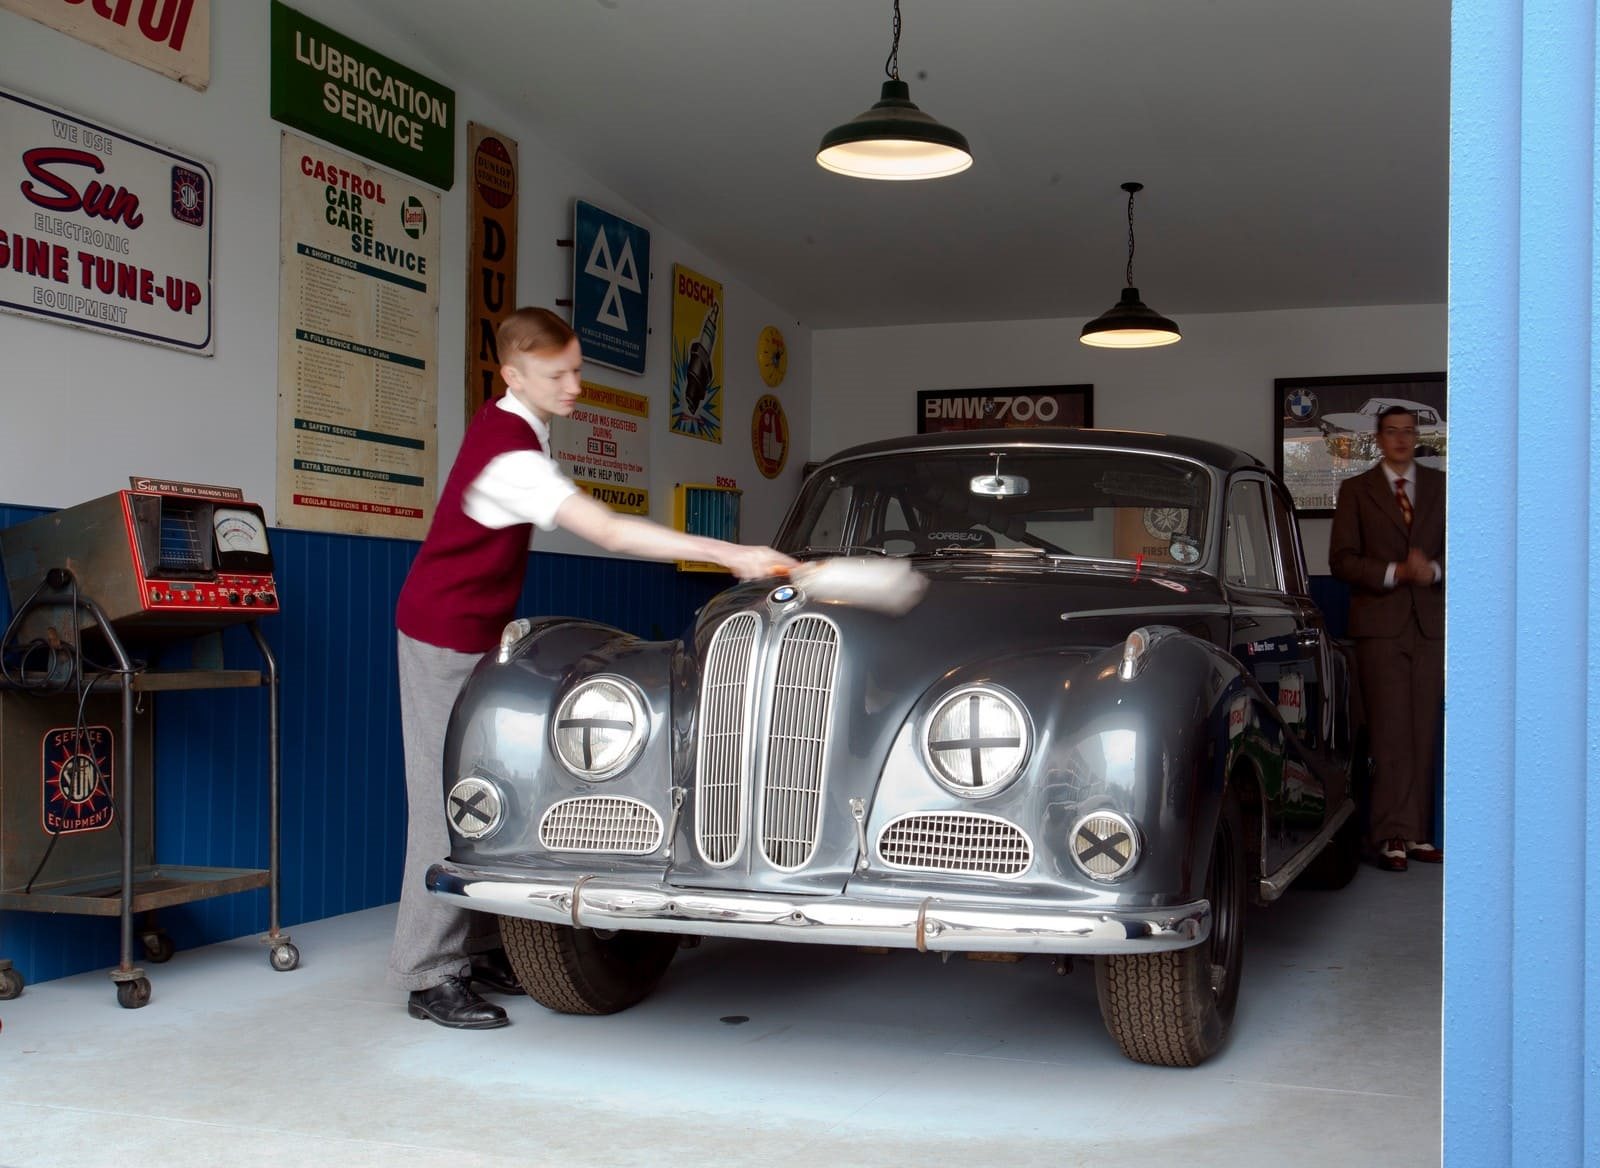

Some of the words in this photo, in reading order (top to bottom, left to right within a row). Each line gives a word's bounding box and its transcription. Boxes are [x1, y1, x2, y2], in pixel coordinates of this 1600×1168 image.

[296, 31, 447, 128] LUBRICATION
[323, 82, 424, 152] SERVICE
[52, 119, 78, 143] WE
[83, 130, 113, 155] USE
[21, 147, 144, 229] Sun
[301, 155, 386, 205] CASTROL
[325, 185, 362, 215] CAR
[34, 213, 130, 254] ELECTRONIC
[325, 205, 374, 238] CARE
[304, 247, 311, 255] A
[311, 249, 332, 261] SHORT
[333, 254, 358, 270] SERVICE
[351, 234, 426, 275] SERVICE
[78, 251, 201, 315] TUNE-UP
[678, 273, 715, 308] BOSCH
[33, 287, 128, 324] EQUIPMENT
[303, 332, 310, 340] A
[310, 334, 325, 344] FULL
[326, 337, 351, 350] SERVICE
[572, 409, 588, 422] YOUR
[588, 413, 598, 425] CAR
[599, 415, 610, 427] WAS
[610, 418, 638, 432] REGISTERED
[925, 397, 986, 419] BMW
[994, 395, 1059, 421] 700
[308, 422, 331, 433] SAFETY
[332, 426, 357, 437] SERVICE
[137, 479, 157, 491] Sun
[301, 461, 321, 471] EXTRA
[322, 464, 351, 475] SERVICES
[353, 468, 361, 477] AS
[362, 470, 390, 481] REQUIRED
[573, 464, 585, 477] MAY
[588, 466, 597, 478] WE
[598, 469, 611, 481] HELP
[614, 472, 629, 483] YOU?
[716, 476, 737, 488] BOSCH
[300, 496, 328, 506] REGULAR
[329, 499, 360, 510] SERVICING
[371, 505, 391, 514] SOUND
[395, 508, 415, 516] SAFETY
[593, 487, 645, 507] DUNLOP
[927, 531, 983, 542] CORBEAU
[1143, 546, 1168, 555] FIRST
[63, 758, 94, 800] SUN
